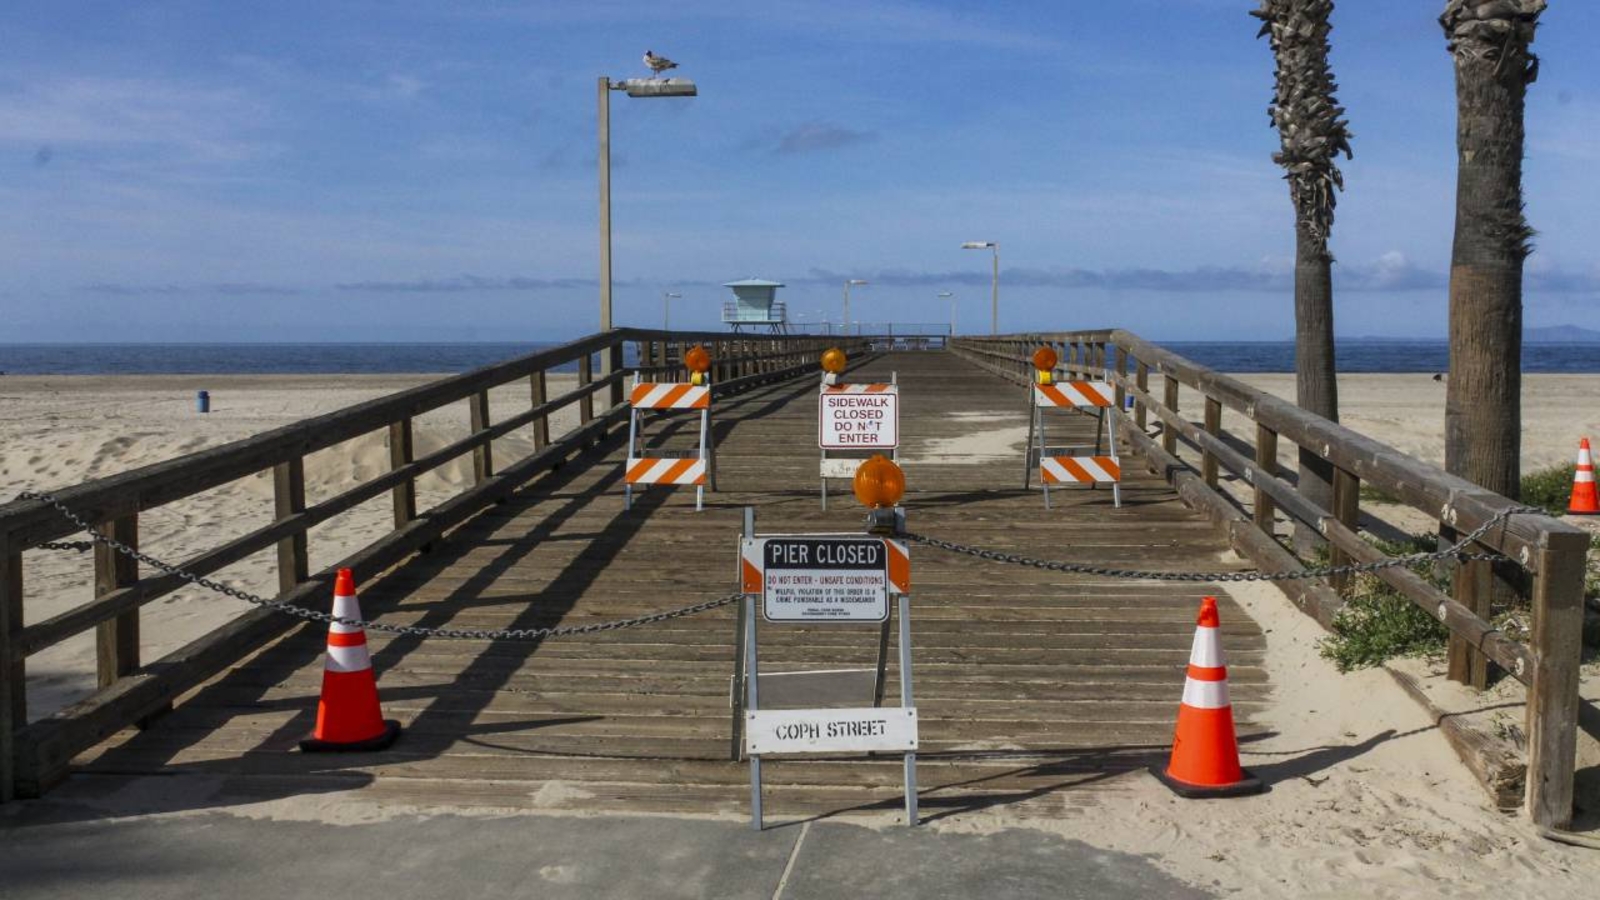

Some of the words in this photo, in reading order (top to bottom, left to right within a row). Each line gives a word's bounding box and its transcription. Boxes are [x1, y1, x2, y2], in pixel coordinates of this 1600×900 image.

[828, 398, 889, 407] SIDEWALK
[834, 410, 883, 419] CLOSED
[834, 422, 852, 431] DO
[858, 422, 882, 431] NT
[839, 433, 879, 443] ENTER
[773, 544, 809, 564] PIER
[816, 544, 877, 564] CLOSED
[767, 575, 776, 585] DO
[779, 575, 791, 585] NOT
[793, 575, 812, 585] ENTER
[819, 575, 844, 585] UNSAFE
[846, 575, 883, 585] CONDITIONS
[776, 723, 820, 740] COPH
[827, 720, 887, 737] STREET
